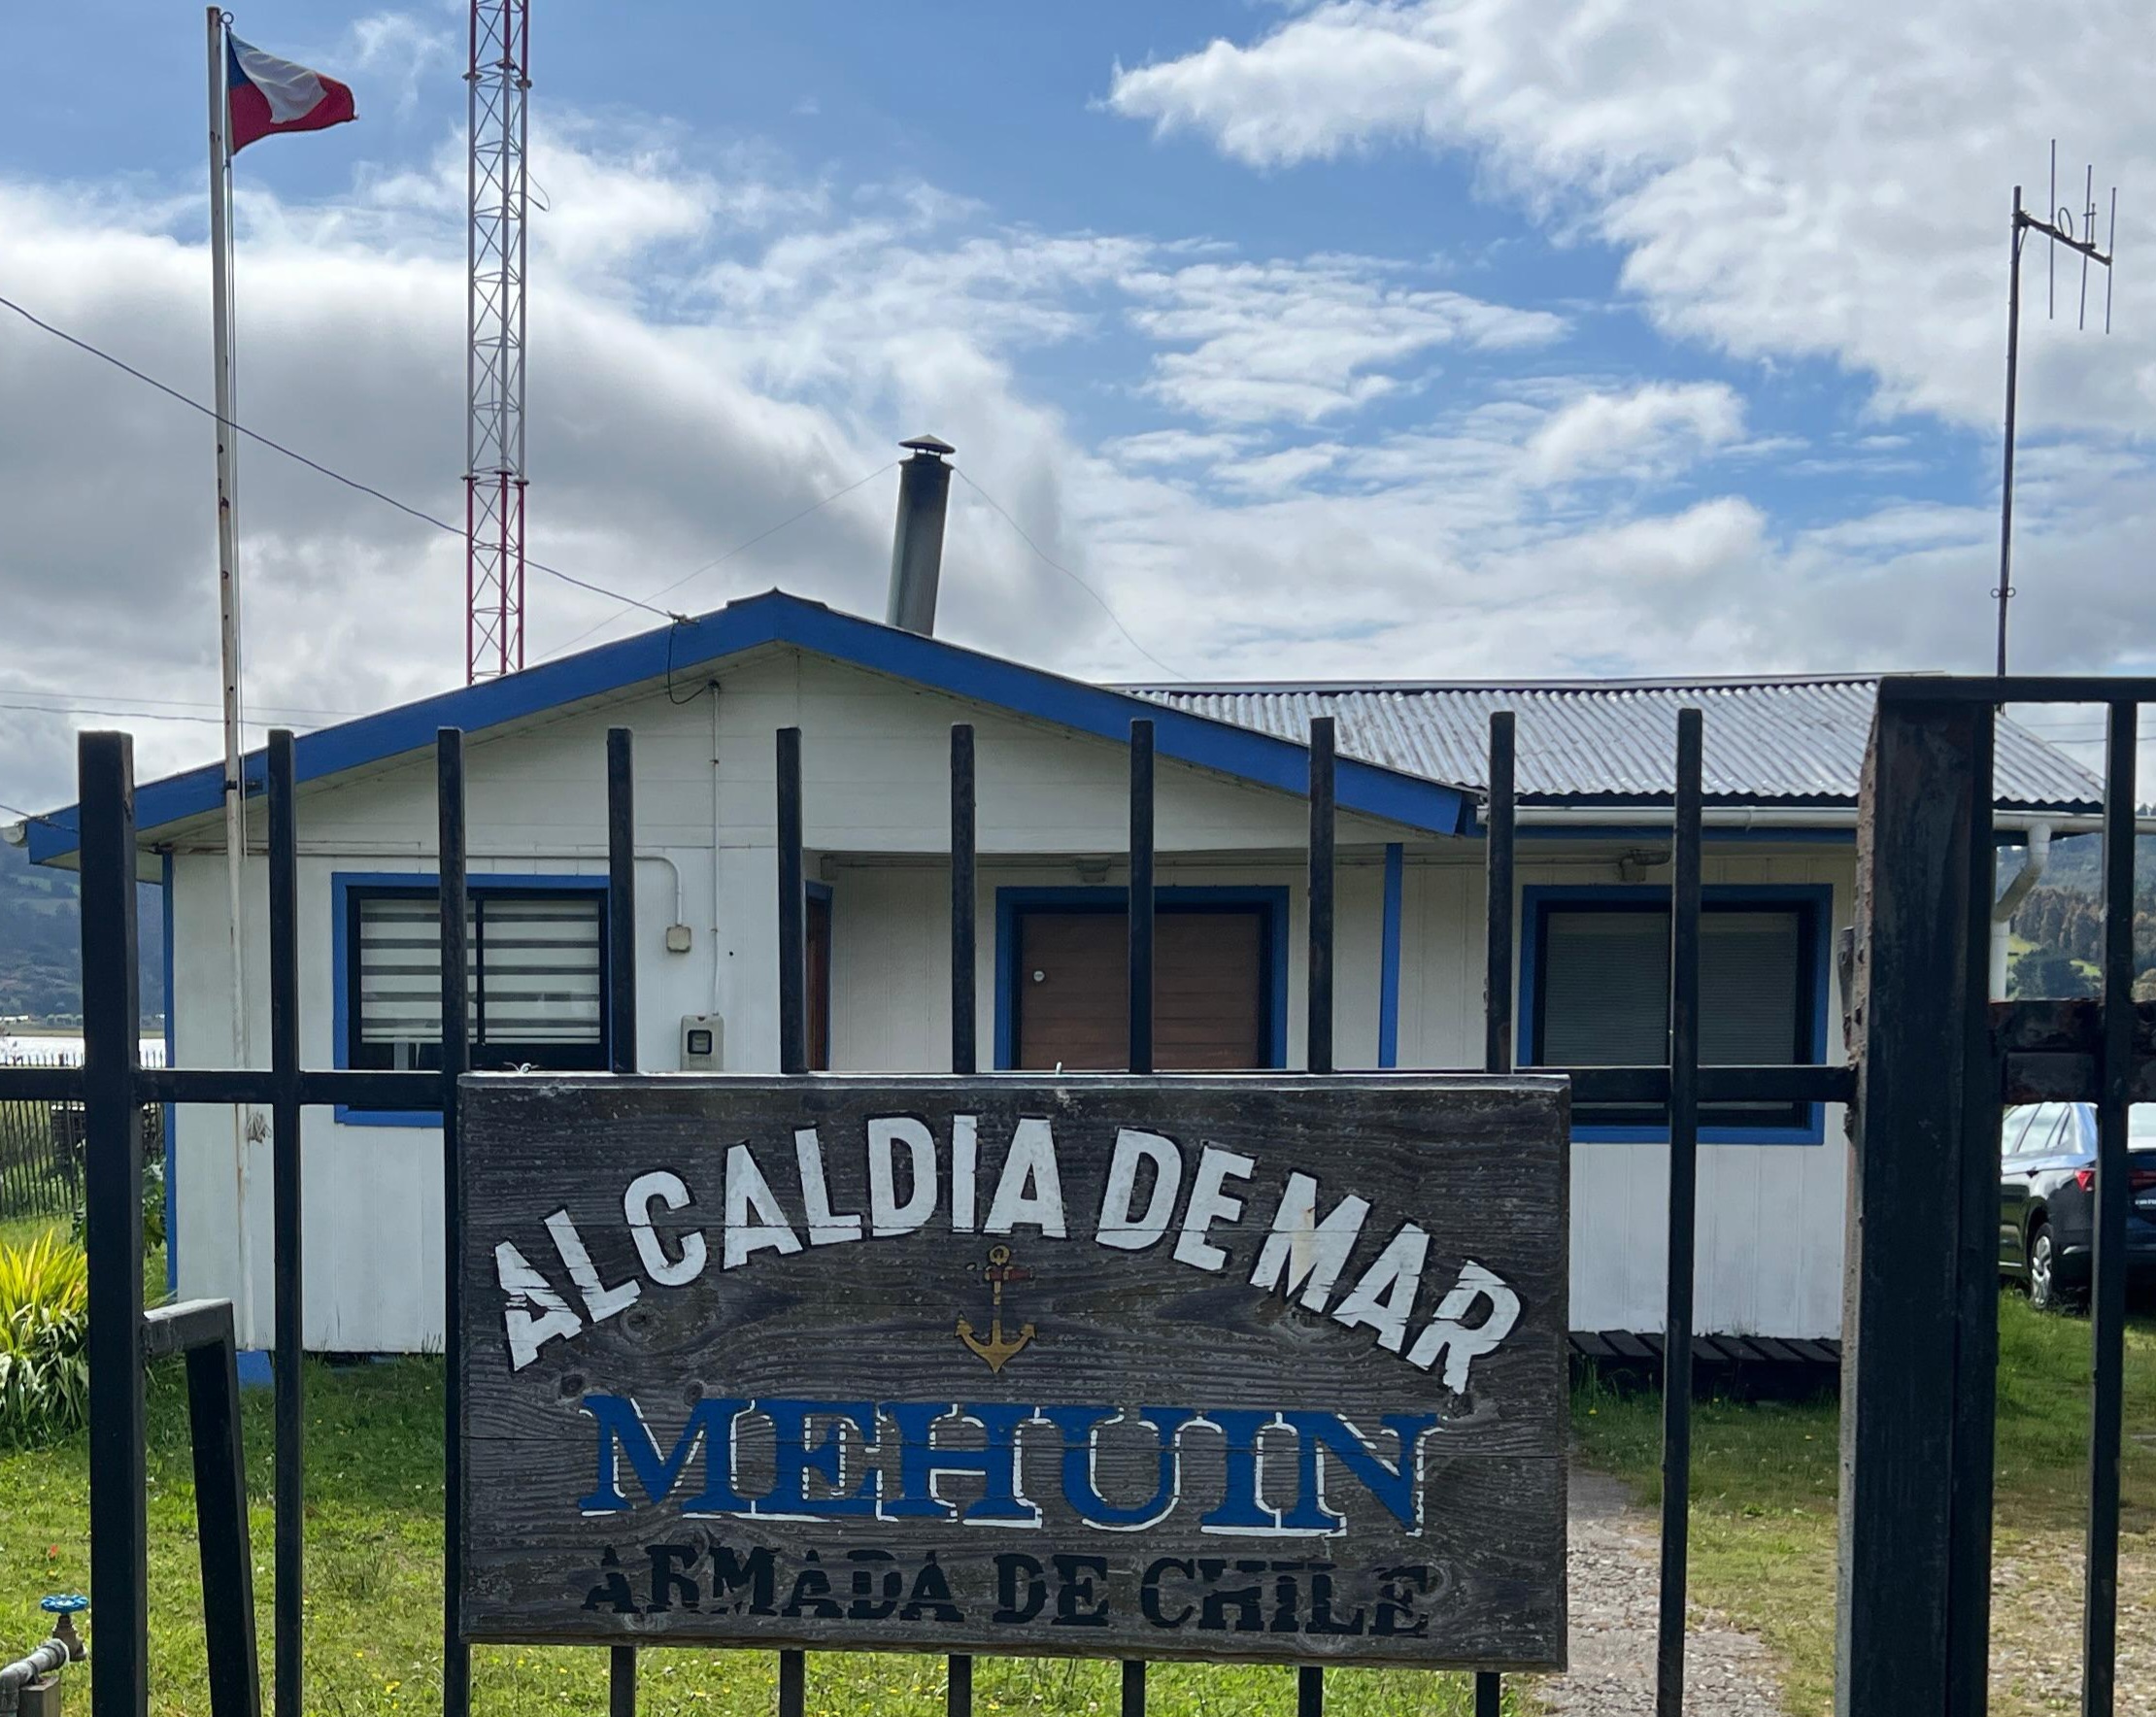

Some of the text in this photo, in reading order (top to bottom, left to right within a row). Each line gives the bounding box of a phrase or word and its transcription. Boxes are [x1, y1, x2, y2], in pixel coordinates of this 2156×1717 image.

[493, 1113, 1522, 1396] ALCALDIA DE MAR
[578, 1394, 1447, 1537] MEHUIN
[581, 1544, 1431, 1639] ARMADA DE CHILE
